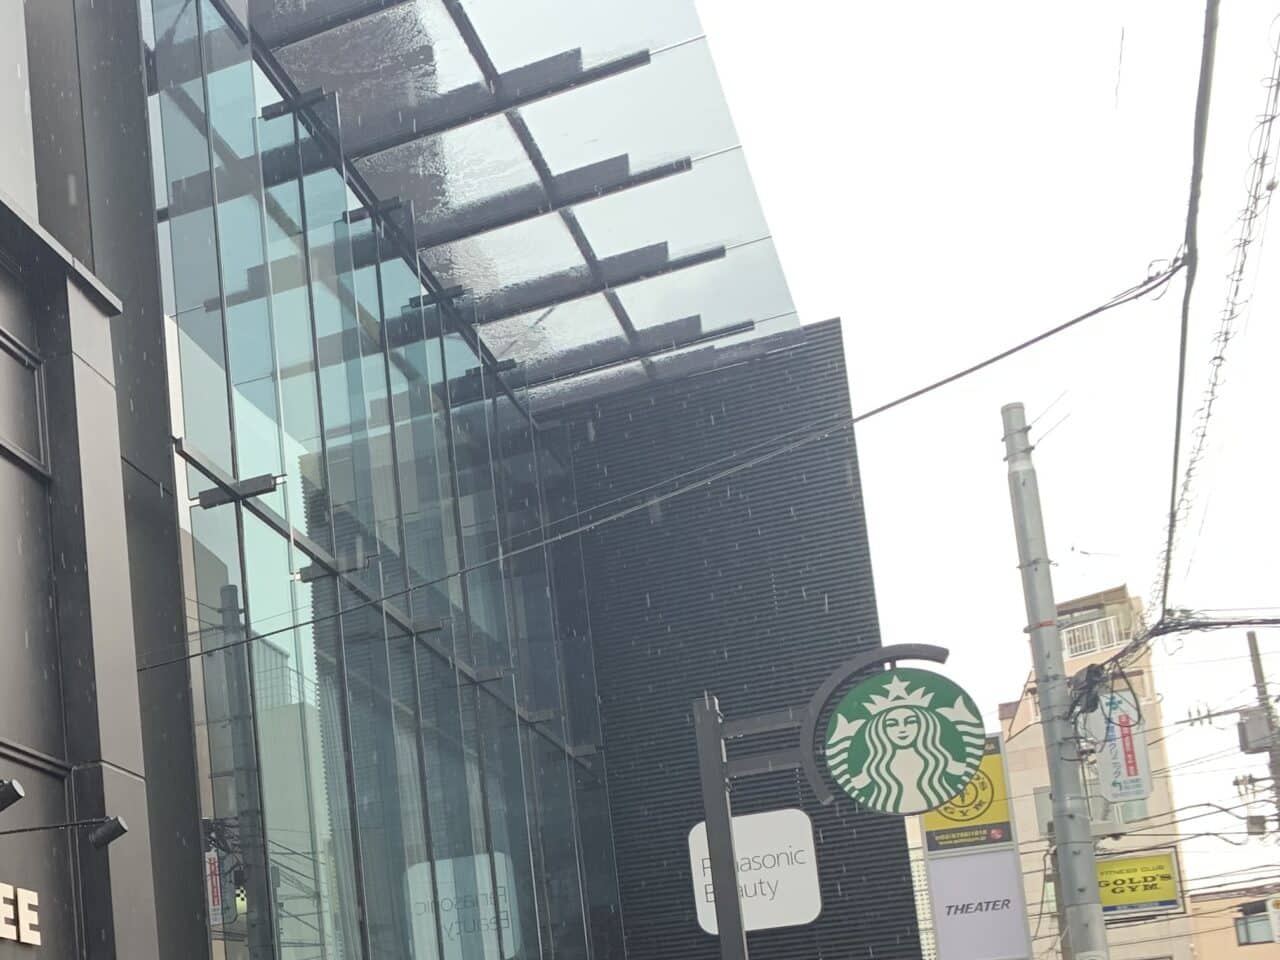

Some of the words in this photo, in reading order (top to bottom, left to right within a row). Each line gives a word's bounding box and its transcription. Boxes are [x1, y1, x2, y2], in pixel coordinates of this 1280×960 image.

[701, 845, 808, 877] Pasonic
[1098, 873, 1172, 888] GOLD'S
[1111, 883, 1161, 894] GYM
[704, 878, 780, 904] Buty
[945, 898, 1011, 916] THEATER
